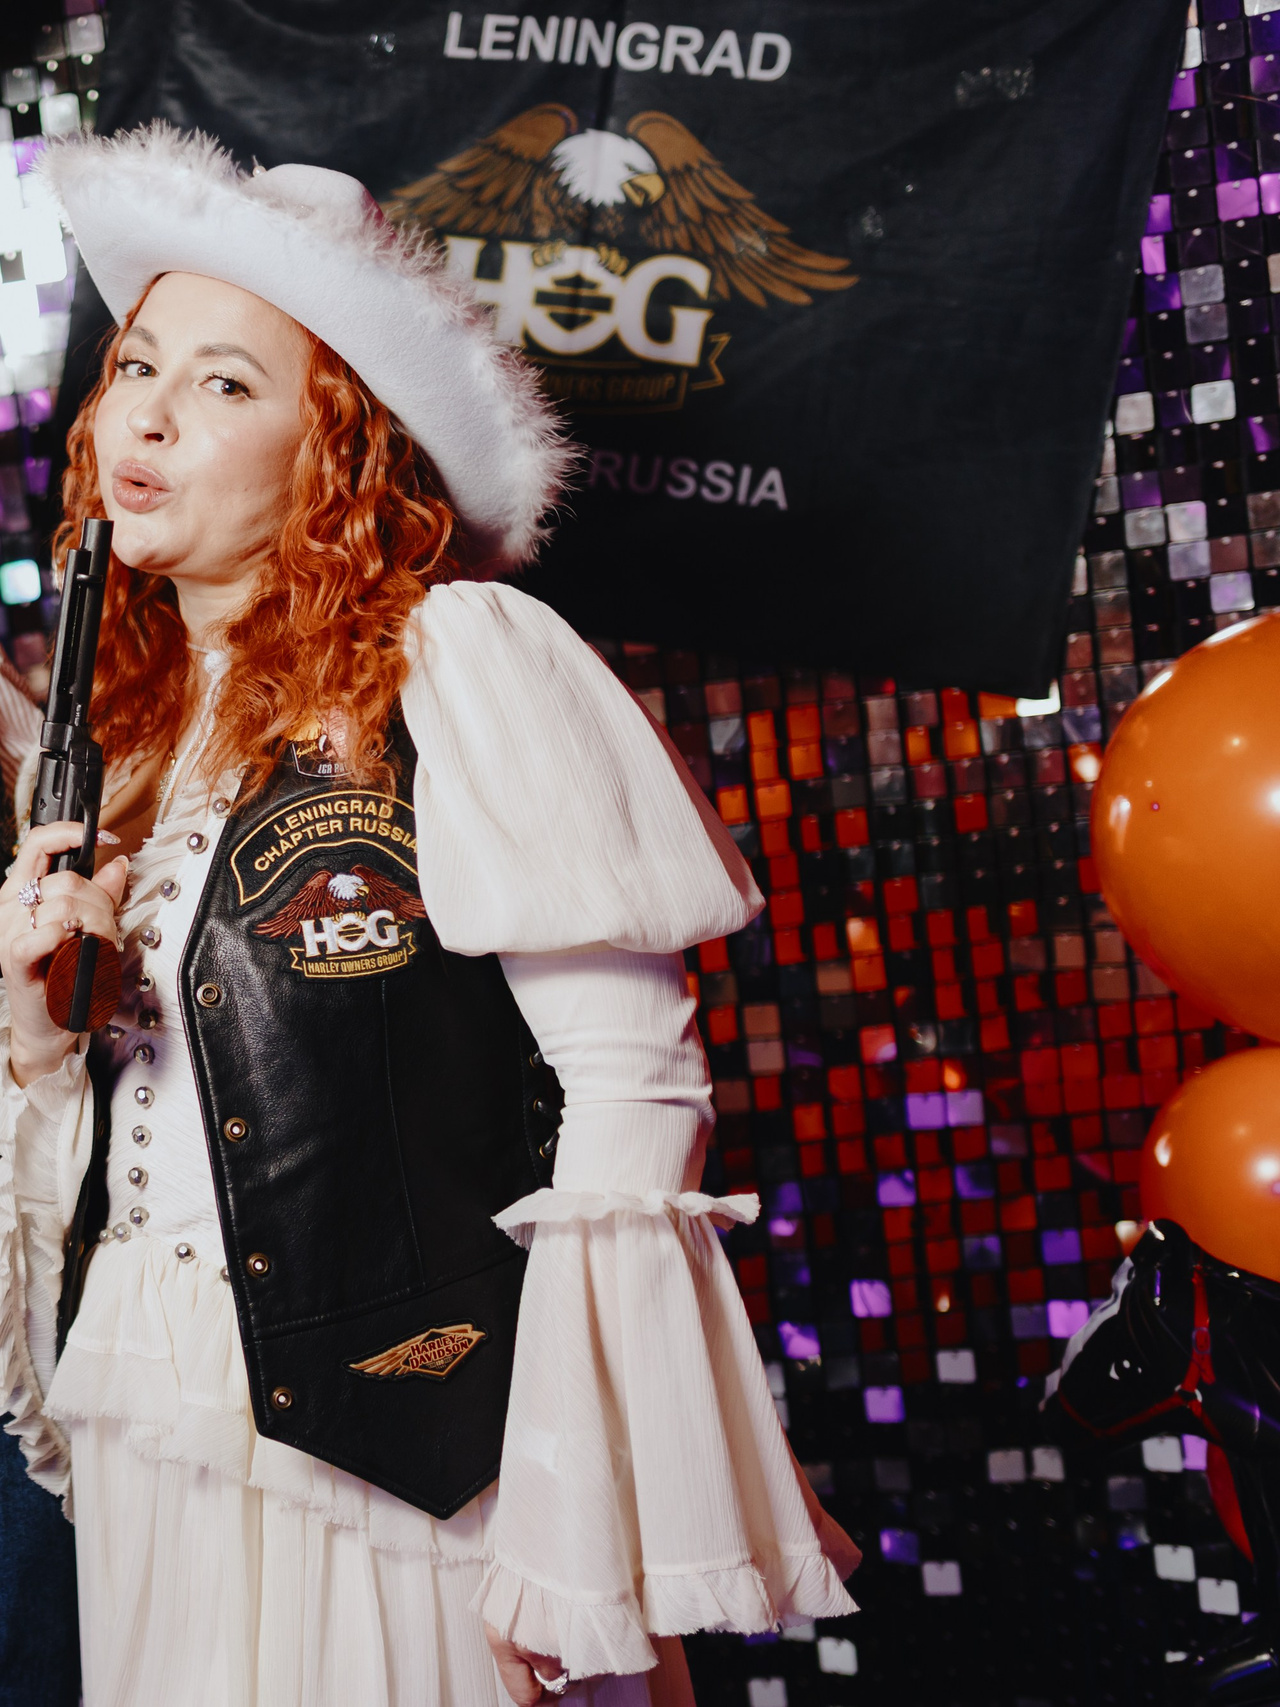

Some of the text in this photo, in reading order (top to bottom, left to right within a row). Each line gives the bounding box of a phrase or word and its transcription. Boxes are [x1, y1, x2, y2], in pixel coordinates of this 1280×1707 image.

[443, 12, 792, 81] LENINGRAD
[443, 235, 714, 367] HOG
[589, 450, 788, 511] RUSSIA
[274, 799, 393, 837] LENINGRAD
[254, 818, 343, 871] CHAPTER
[300, 909, 399, 957] HOG
[308, 950, 403, 974] HARLEY OWNERS GROUP
[408, 1339, 469, 1370] DAVIDSON
